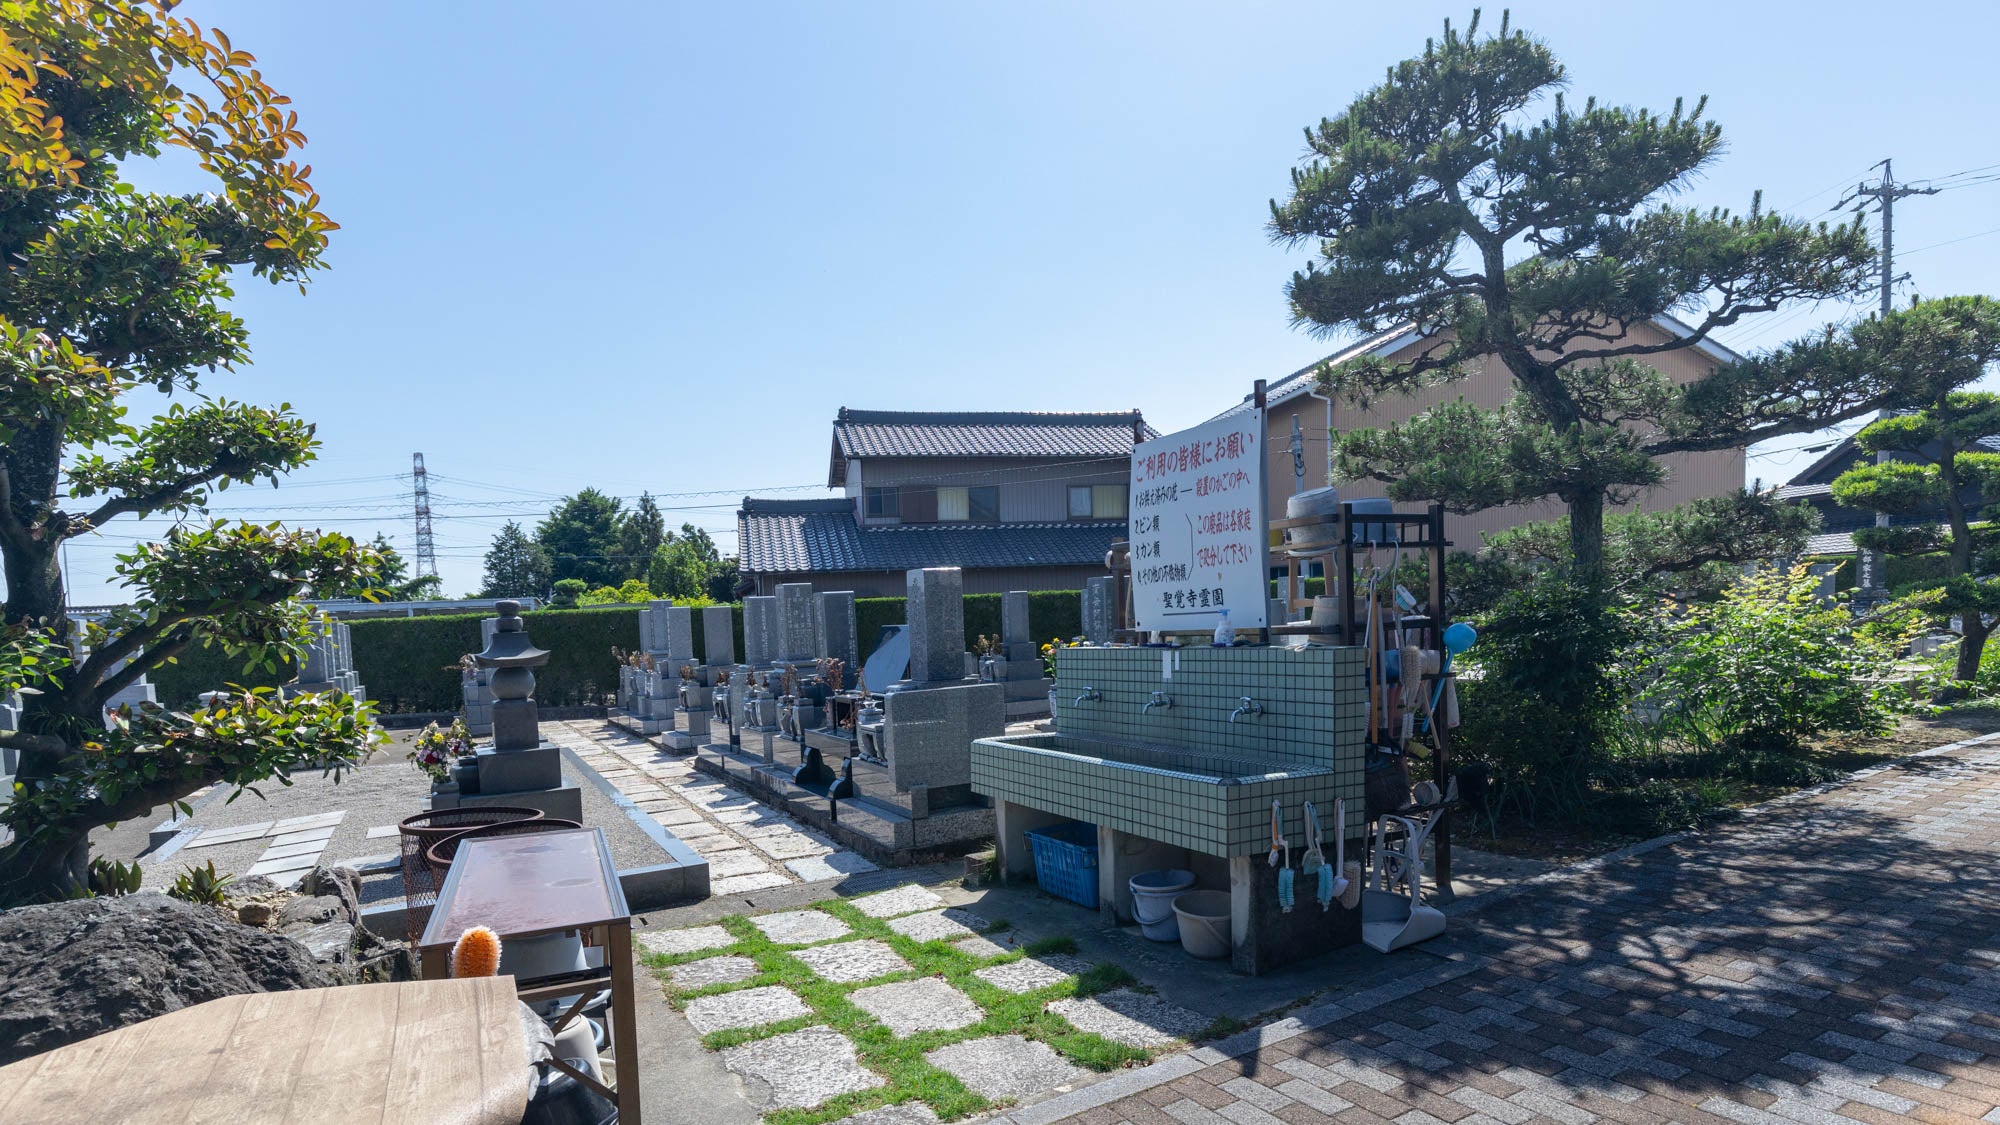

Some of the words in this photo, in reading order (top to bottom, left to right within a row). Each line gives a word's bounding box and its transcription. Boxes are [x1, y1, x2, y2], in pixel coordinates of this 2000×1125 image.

[1136, 431, 1253, 483] ご利用の皆様にお願い
[1196, 468, 1250, 497] 設置のかごの中へ
[1197, 507, 1252, 535] この廃品は各家庭
[1197, 542, 1253, 569] で処分して下さい
[1162, 588, 1225, 609] 聖覚寺霊園
